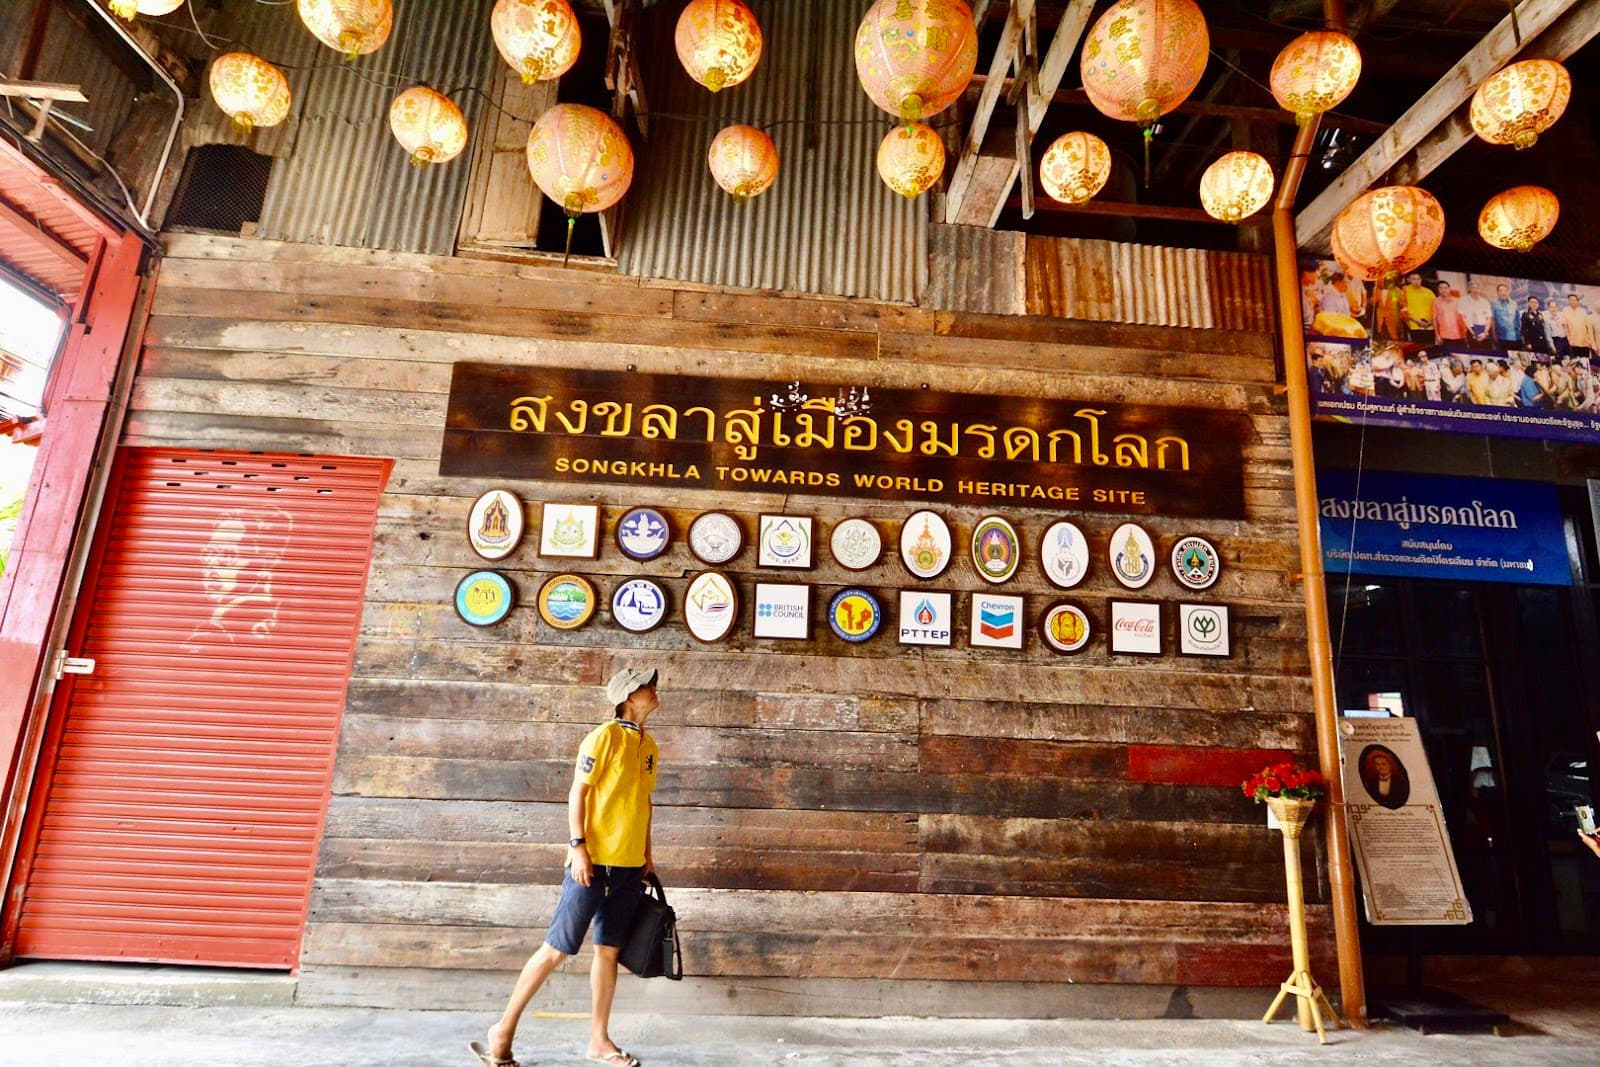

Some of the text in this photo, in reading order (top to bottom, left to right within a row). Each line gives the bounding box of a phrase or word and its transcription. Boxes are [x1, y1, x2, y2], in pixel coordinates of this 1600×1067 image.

[509, 394, 1190, 471] สงขลาสู่เมืองมรดกโลก
[555, 458, 1145, 505] SONGKHLA TOWARDS WORLD HERITAGE SITE
[1321, 496, 1518, 530] สงขลาสู่มรดกโลก
[773, 603, 804, 612] BRITISH
[981, 601, 1015, 611] Chevron
[773, 611, 804, 619] COUNCIL
[901, 628, 949, 640] PTTEP
